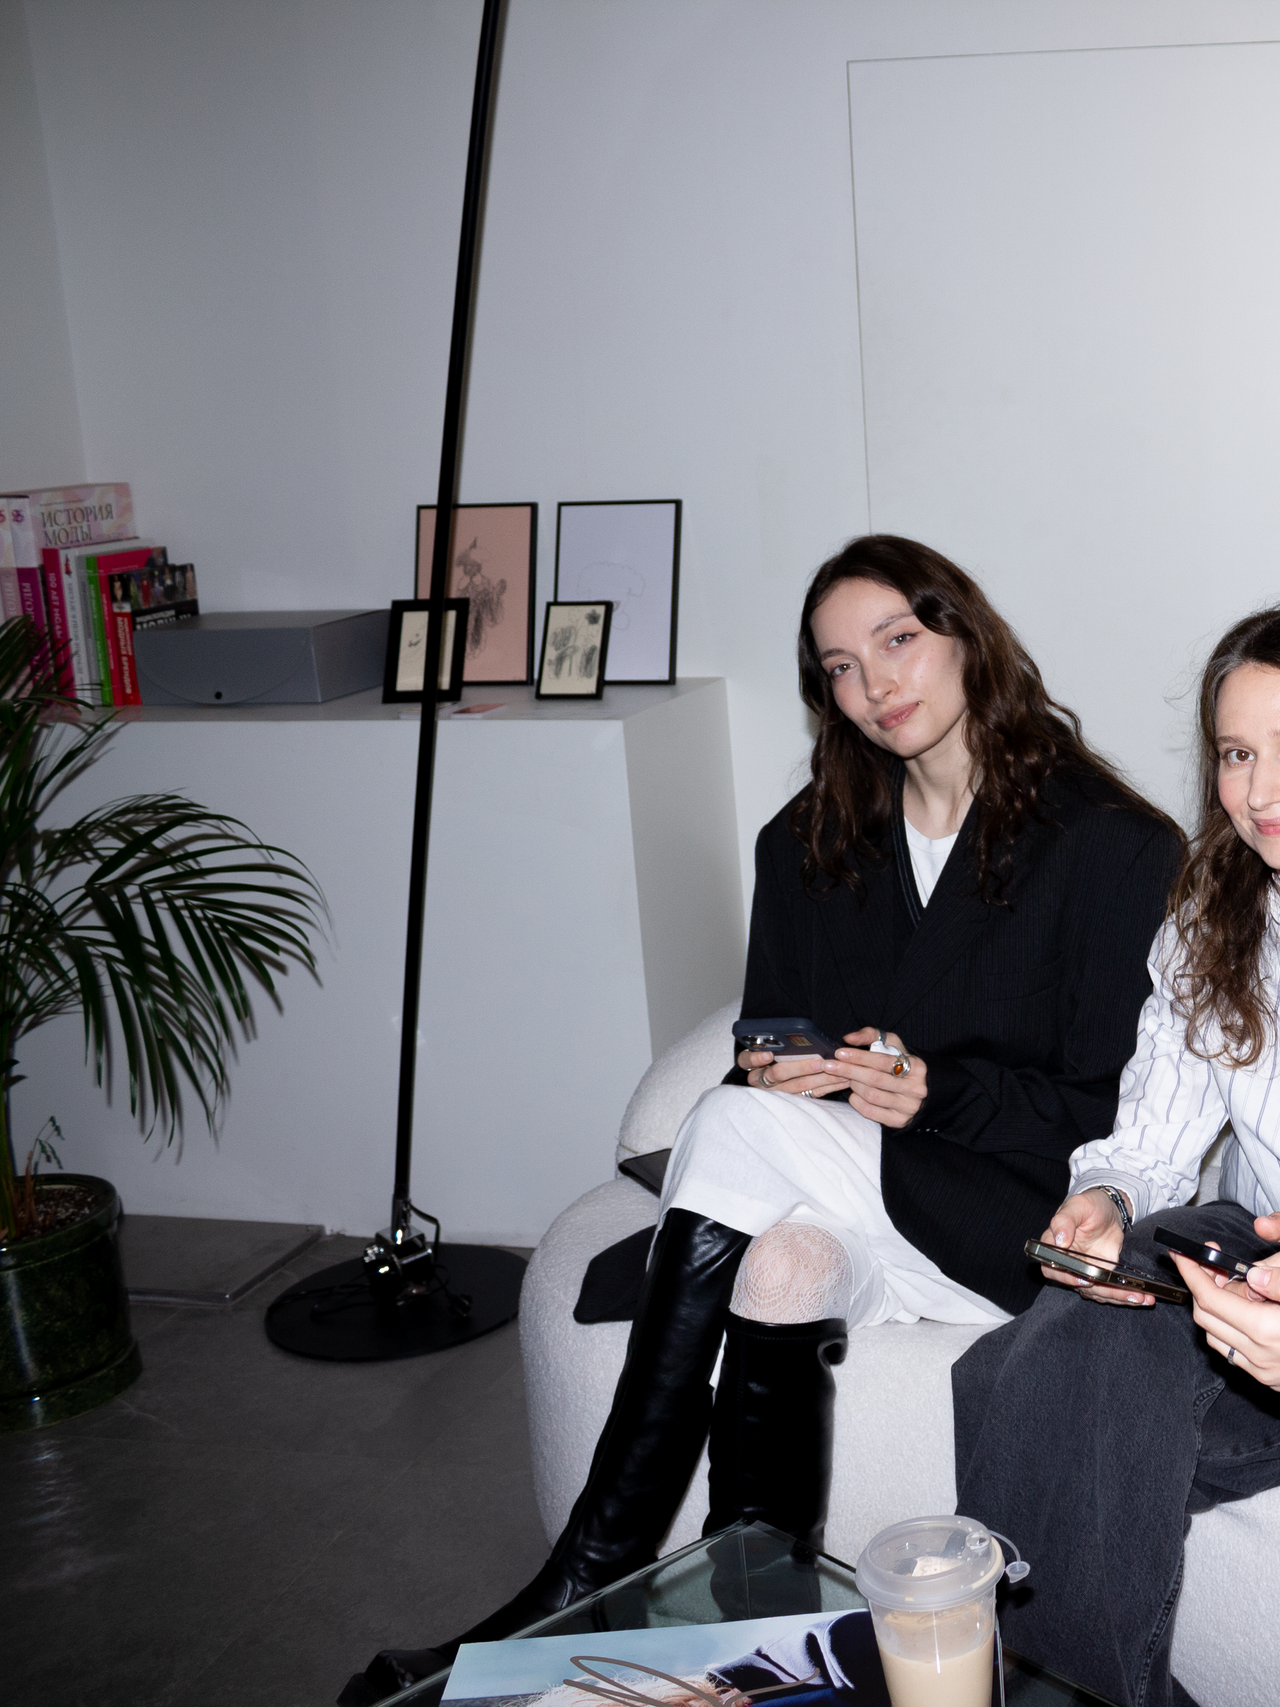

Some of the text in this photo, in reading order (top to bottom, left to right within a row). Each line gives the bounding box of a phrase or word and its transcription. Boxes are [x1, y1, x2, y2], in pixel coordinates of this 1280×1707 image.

[41, 503, 114, 528] ИСТОРИЯ
[44, 524, 92, 546] МОДЫ
[48, 572, 57, 588] 100
[50, 590, 60, 606] ЛЕТ
